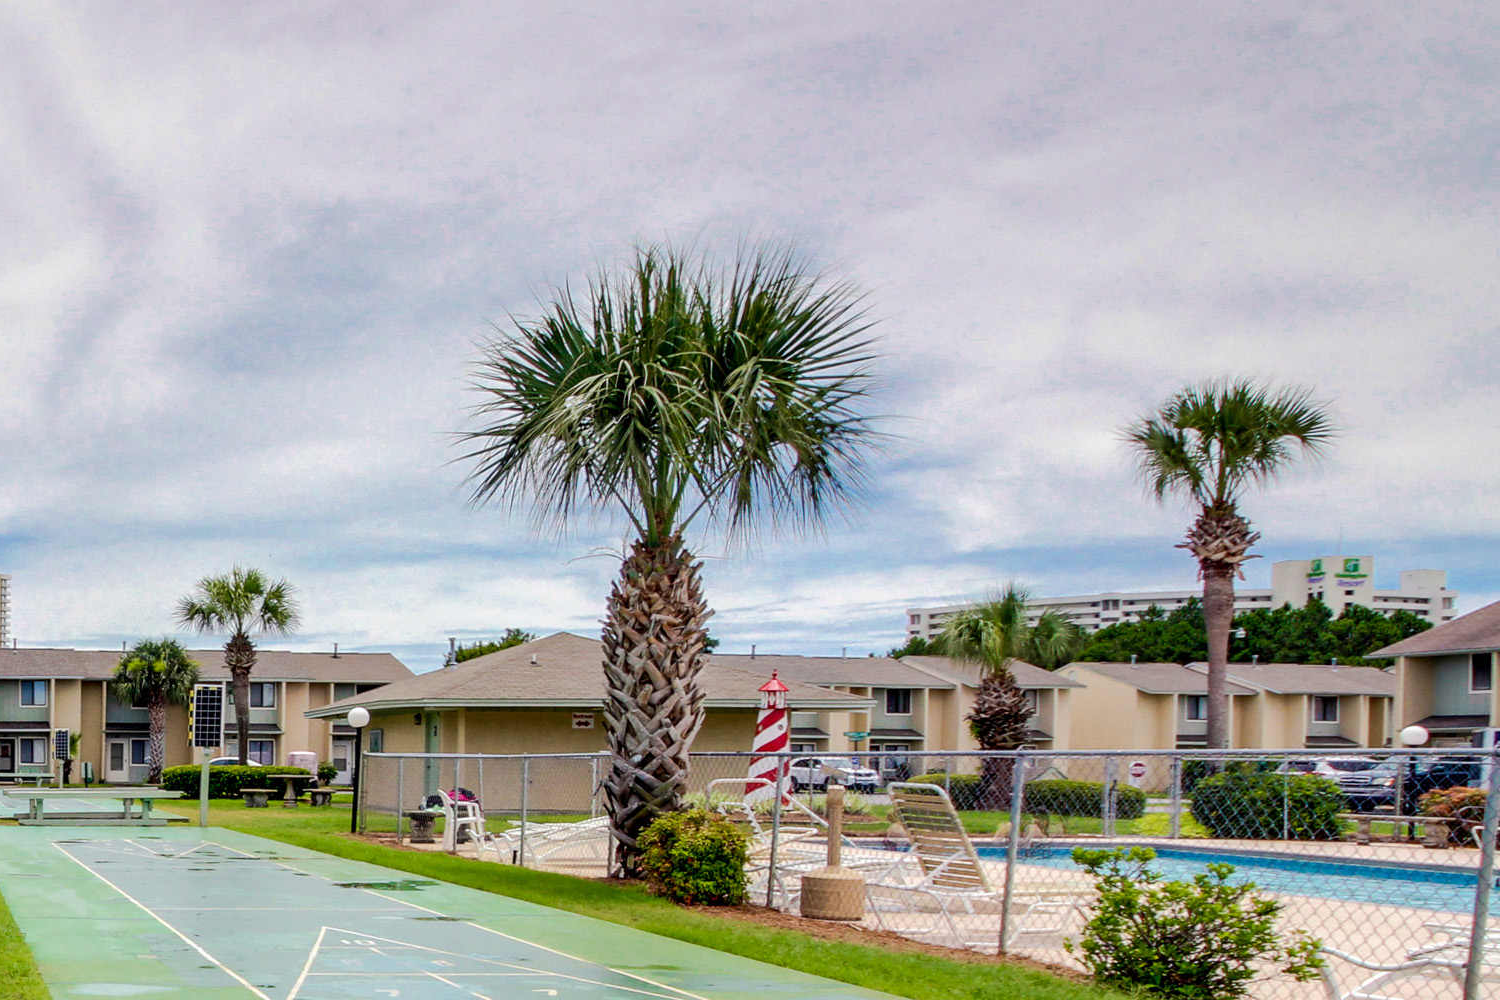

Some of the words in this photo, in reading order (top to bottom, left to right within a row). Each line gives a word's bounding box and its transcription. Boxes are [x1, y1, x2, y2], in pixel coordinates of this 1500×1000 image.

[1130, 766, 1147, 774] STOP
[375, 989, 401, 997] 7
[531, 988, 559, 997] 7
